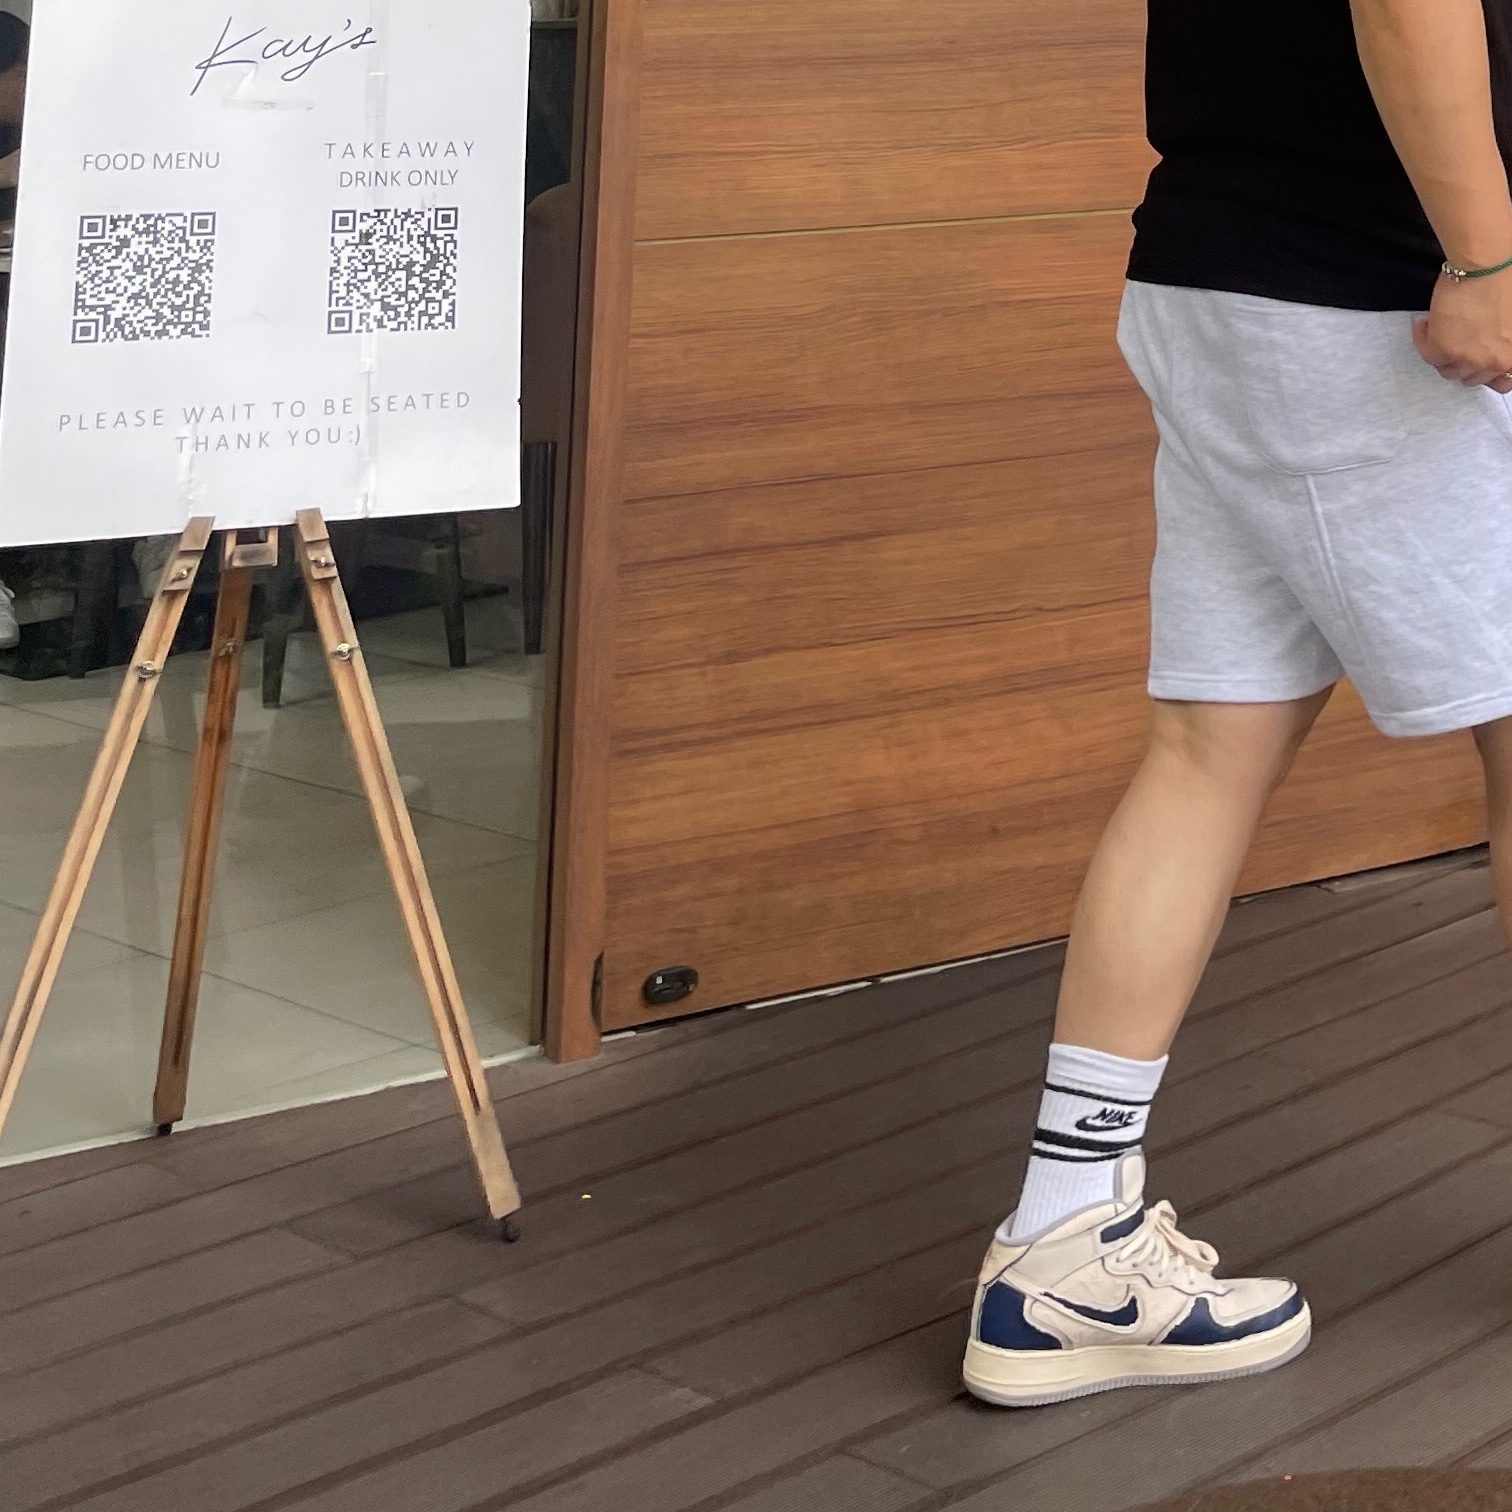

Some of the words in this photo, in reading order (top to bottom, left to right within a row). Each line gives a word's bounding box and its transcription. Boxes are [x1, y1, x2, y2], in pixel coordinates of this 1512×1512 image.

[189, 15, 378, 96] Kay's
[82, 152, 146, 172] FOOD
[152, 150, 221, 170] MENU
[324, 140, 476, 160] TAKEAWAY
[339, 170, 401, 189] DRINK
[407, 168, 459, 187] ONLY
[58, 408, 165, 432] PLEASE
[183, 402, 257, 425] WAIT
[272, 400, 306, 420] TO
[323, 397, 354, 417] BE
[369, 391, 471, 414] SEATED
[175, 430, 272, 454] THANK
[1092, 1107, 1138, 1124] NIKE
